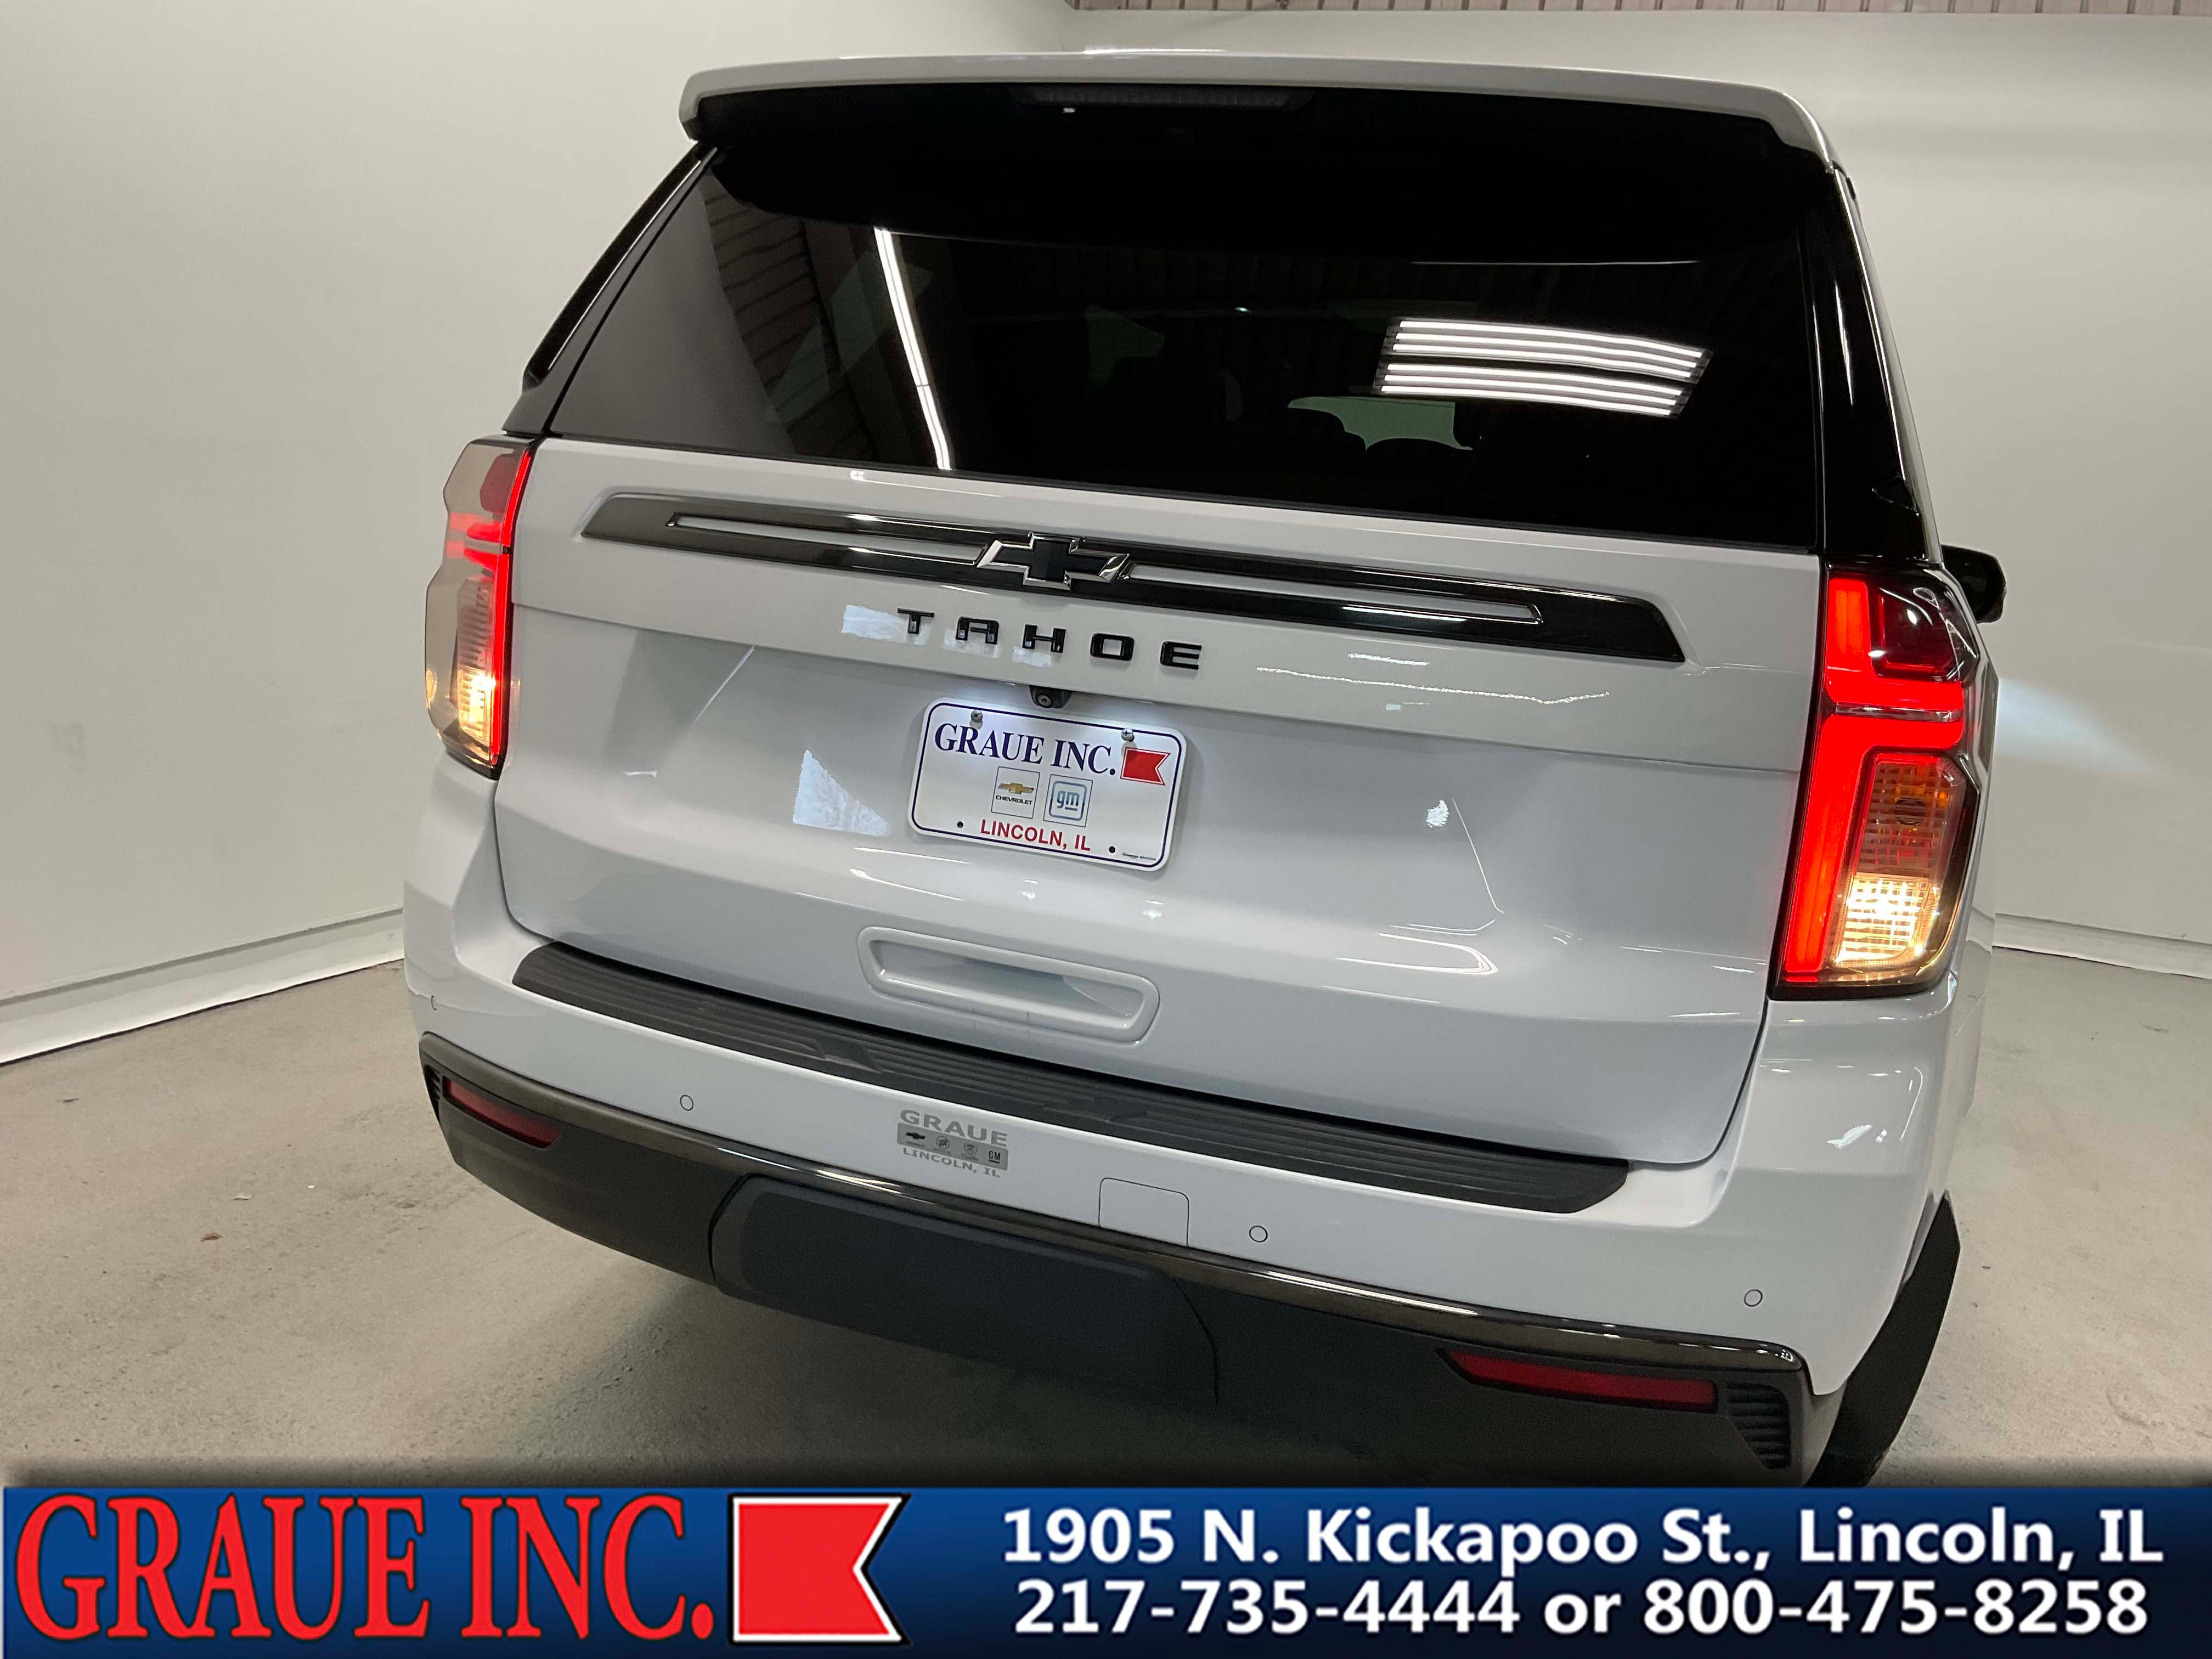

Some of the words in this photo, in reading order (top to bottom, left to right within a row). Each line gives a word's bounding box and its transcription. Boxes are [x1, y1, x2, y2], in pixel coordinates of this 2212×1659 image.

[897, 607, 1203, 670] TAHOE
[934, 723, 1045, 764] GRAUE
[1051, 740, 1116, 776] INC.
[995, 795, 1033, 805] CHEVROLET
[1056, 789, 1080, 810] gm
[980, 819, 1067, 850] LINCOLN,
[1075, 834, 1091, 851] IL
[900, 1109, 1007, 1147] GRAUE
[903, 1147, 977, 1173] LINCOLN,
[983, 1168, 1001, 1178] IL
[989, 1150, 1001, 1161] GM
